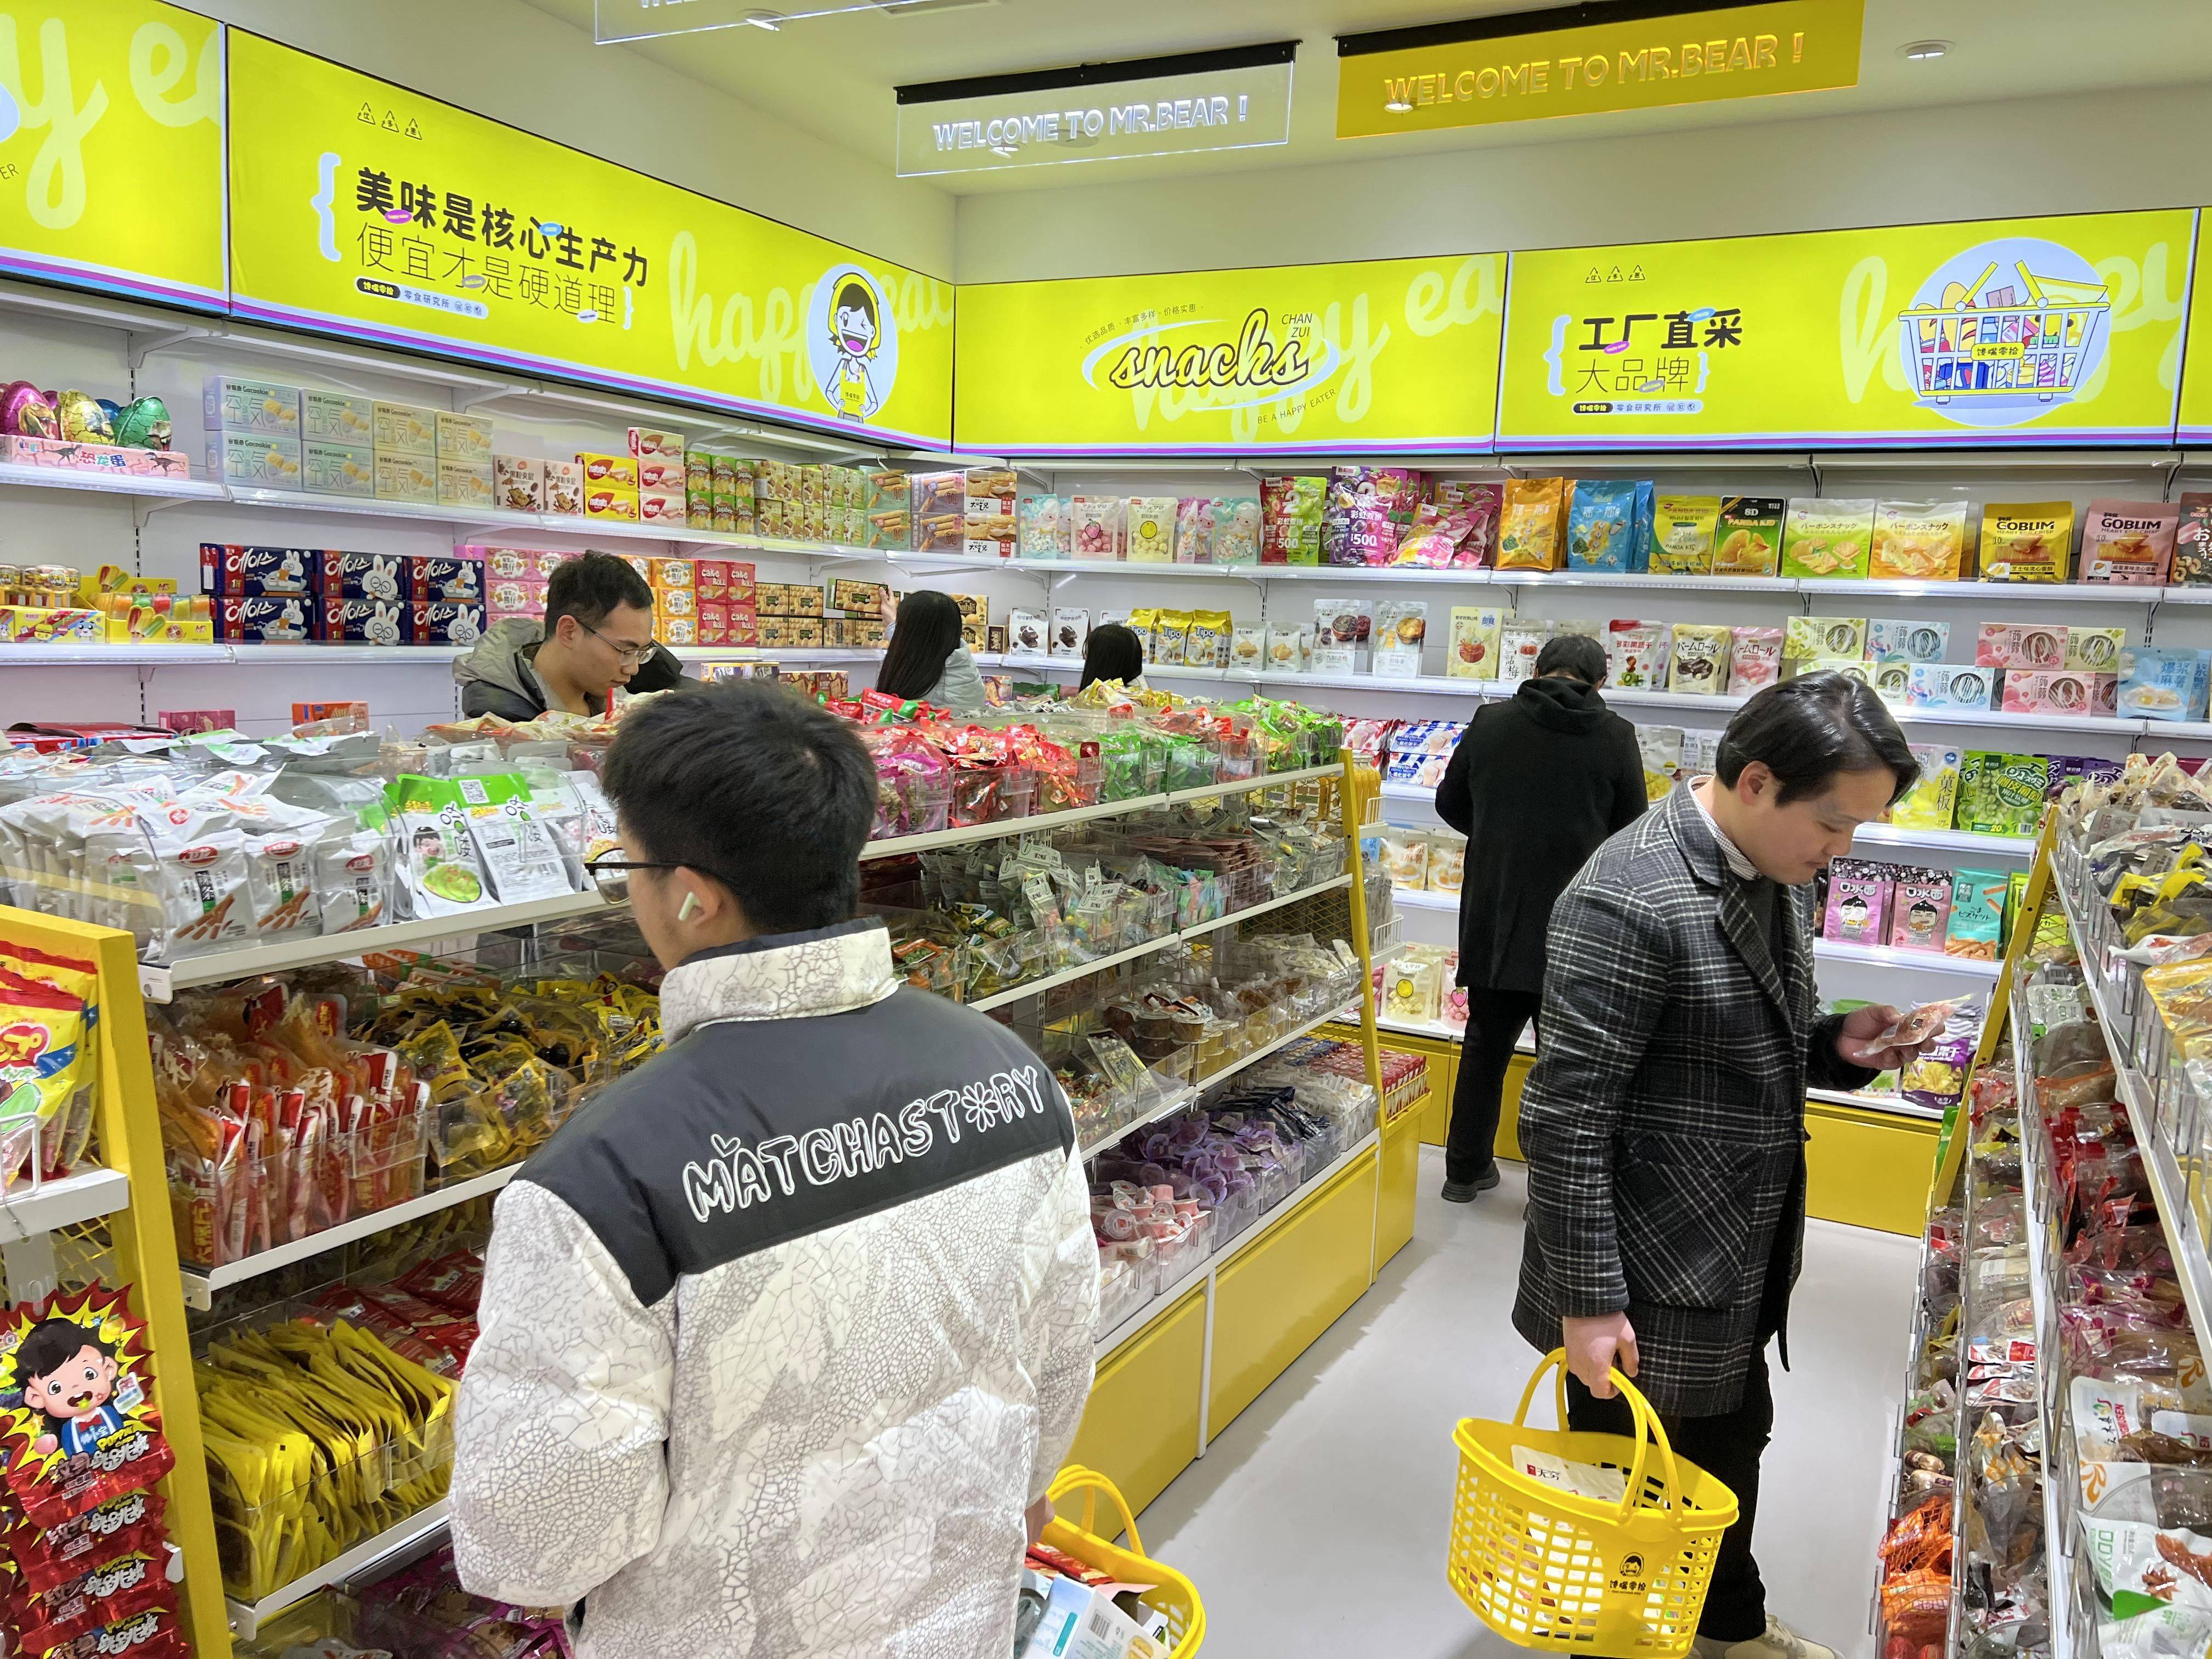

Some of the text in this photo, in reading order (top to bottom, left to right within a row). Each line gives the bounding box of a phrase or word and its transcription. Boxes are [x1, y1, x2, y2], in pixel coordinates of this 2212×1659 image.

[1384, 59, 1550, 109] WELCOME
[1559, 54, 1610, 91] TO
[1617, 33, 1779, 85] MR.BEAR
[932, 113, 1059, 151] WELCOME
[1064, 108, 1104, 140] TO
[1109, 95, 1228, 136] MR.BEAR
[357, 166, 648, 287] 美味是核心生产力
[357, 222, 616, 325] 便宜才是硬道理
[404, 290, 450, 309] 零食研究所
[1085, 303, 1197, 345] 优选品质 丰富多样 价格实惠
[1281, 313, 1313, 325] CHAN
[1291, 327, 1311, 338] ZUI
[1578, 308, 1743, 351] 工厂直采
[1109, 307, 1310, 389] snacks
[1575, 356, 1690, 394] 大品牌
[243, 386, 269, 396] Gocookie
[1257, 388, 1336, 425] BE A HAPPY EATER
[1616, 403, 1662, 412] 零食研究所
[1996, 521, 2055, 531] GOBLIM
[2101, 518, 2162, 530] GOBLIM
[701, 568, 720, 579] cake
[731, 569, 748, 580] cake
[702, 612, 720, 624] cake
[731, 613, 749, 623] cake
[1164, 627, 1182, 639] Tipo
[1195, 626, 1215, 638] Tipo
[1677, 642, 1721, 654] バームロール
